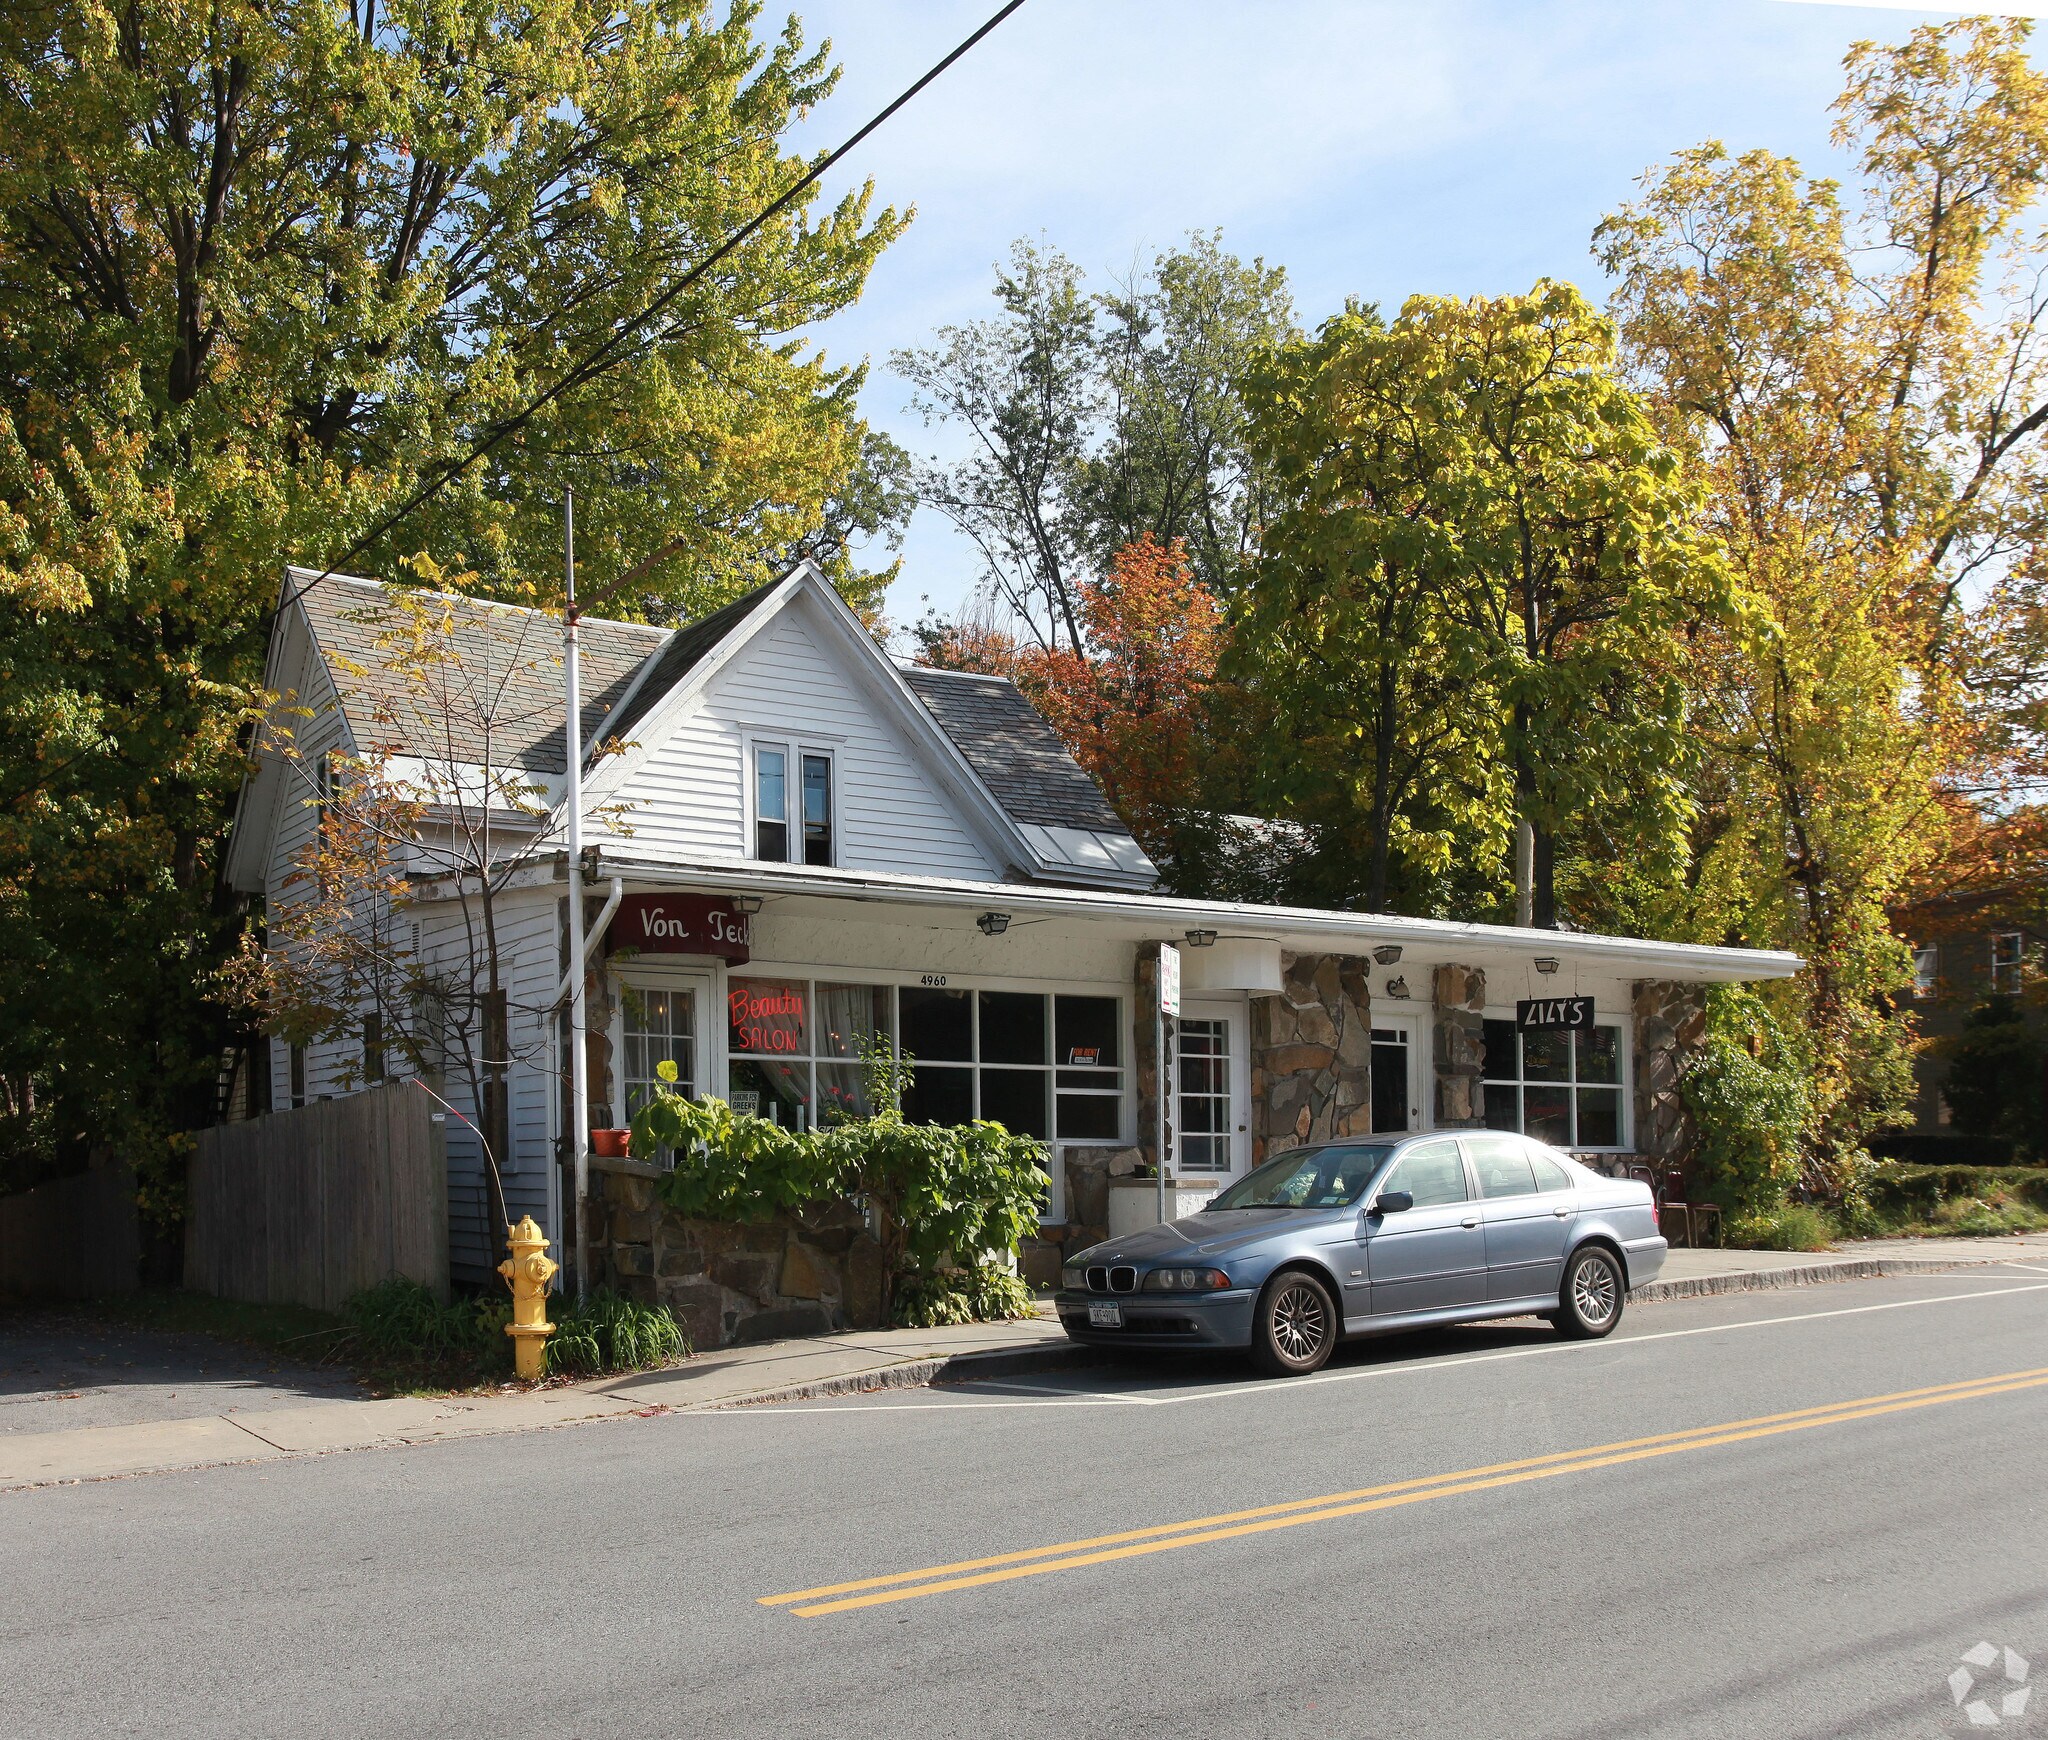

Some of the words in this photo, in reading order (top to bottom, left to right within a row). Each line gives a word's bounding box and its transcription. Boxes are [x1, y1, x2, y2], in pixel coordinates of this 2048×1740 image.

[640, 907, 690, 938] Von
[921, 975, 946, 986] 4960
[728, 987, 804, 1028] Beauty
[1524, 998, 1585, 1026] LILY'S
[739, 1026, 797, 1051] SALON
[1073, 1048, 1083, 1057] FOR
[1083, 1048, 1097, 1057] RENT
[731, 1093, 748, 1101] PARKING
[748, 1093, 757, 1101] FOR
[732, 1101, 756, 1110] GREEKS
